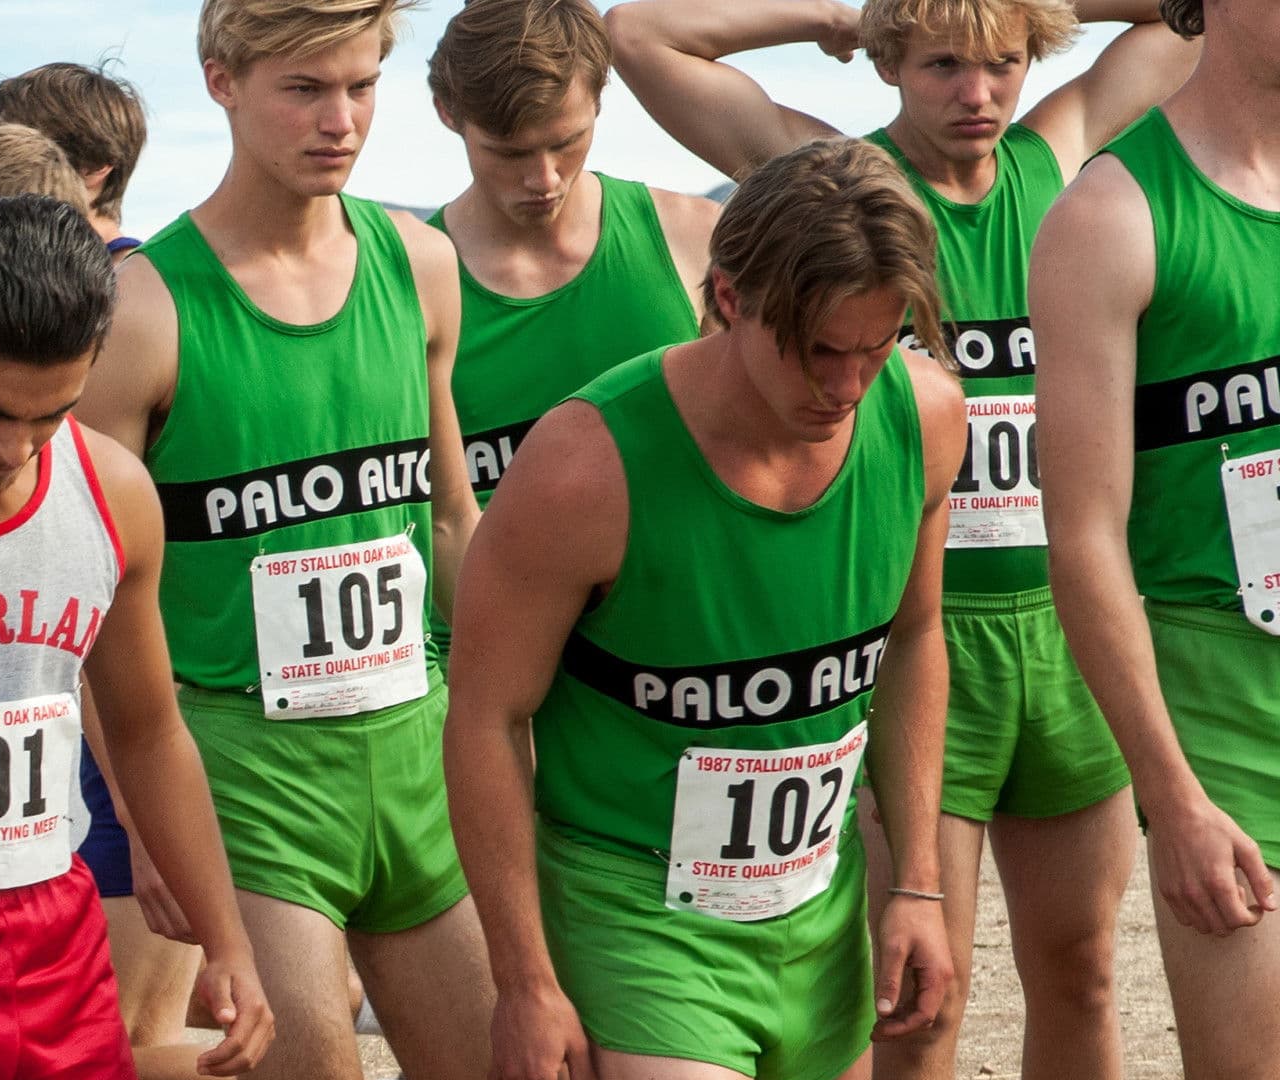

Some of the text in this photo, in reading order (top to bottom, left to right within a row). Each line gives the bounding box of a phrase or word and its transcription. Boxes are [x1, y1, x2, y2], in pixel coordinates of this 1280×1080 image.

[965, 403, 1010, 416] ALLION
[1185, 366, 1280, 433] PAL
[951, 421, 1040, 492] 10
[1239, 460, 1273, 479] 1987
[205, 464, 345, 534] PALO
[971, 496, 1039, 510] QUALIFYING
[267, 560, 297, 576] 1987
[300, 552, 361, 572] STALLION
[363, 548, 384, 564] OAK
[298, 563, 404, 659] 105
[282, 645, 415, 680] STATE QUALIFYING MEET
[633, 637, 885, 722] PALO ALT
[3, 709, 29, 726] OAK
[32, 700, 69, 722] RANCH
[697, 756, 732, 772] 1987
[735, 756, 804, 774] STALLION
[806, 752, 834, 768] OAK
[33, 816, 58, 835] MEET
[720, 767, 843, 860] 102
[692, 861, 736, 878] STATE
[741, 852, 815, 880] QUALIFYING
